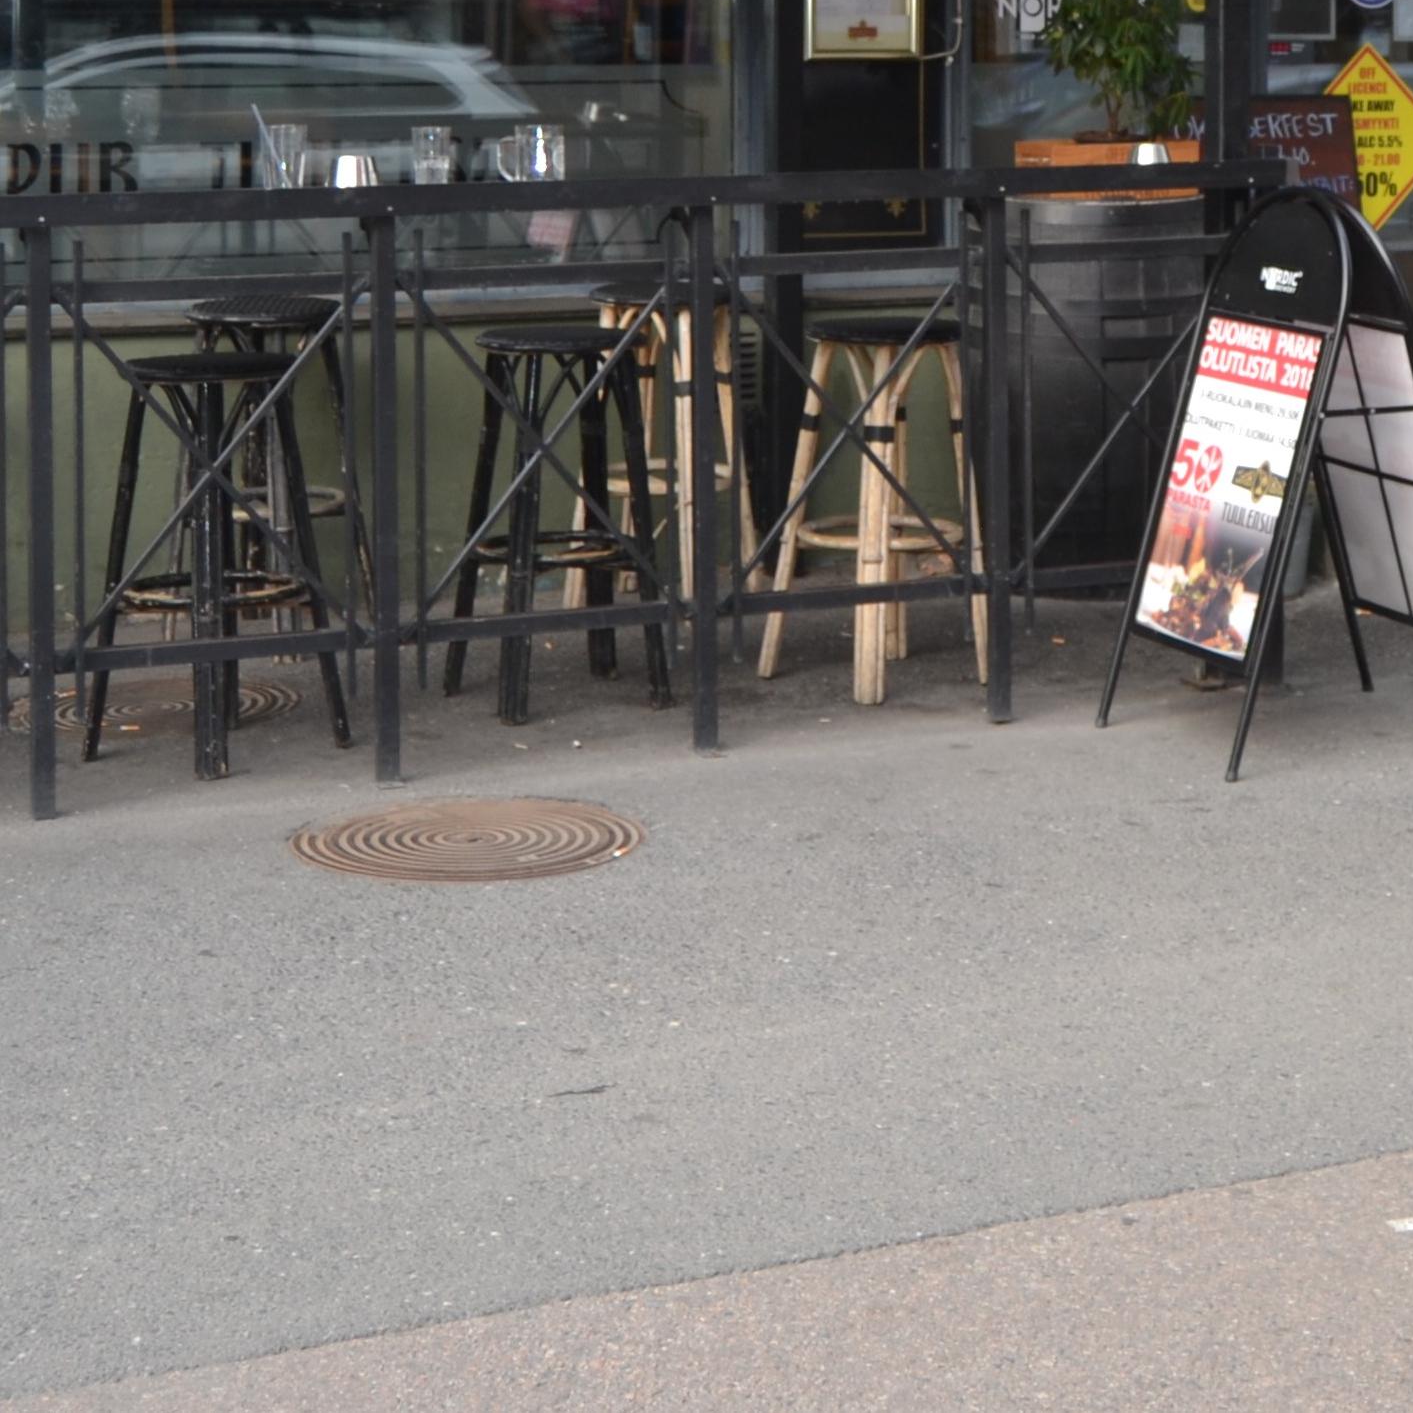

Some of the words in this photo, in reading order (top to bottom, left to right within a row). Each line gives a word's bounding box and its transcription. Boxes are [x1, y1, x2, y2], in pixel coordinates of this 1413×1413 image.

[1359, 67, 1376, 79] OFF
[1367, 100, 1395, 112] AWAY
[1205, 317, 1272, 352] SUOMEN
[1200, 345, 1277, 383] OLUTLISTA
